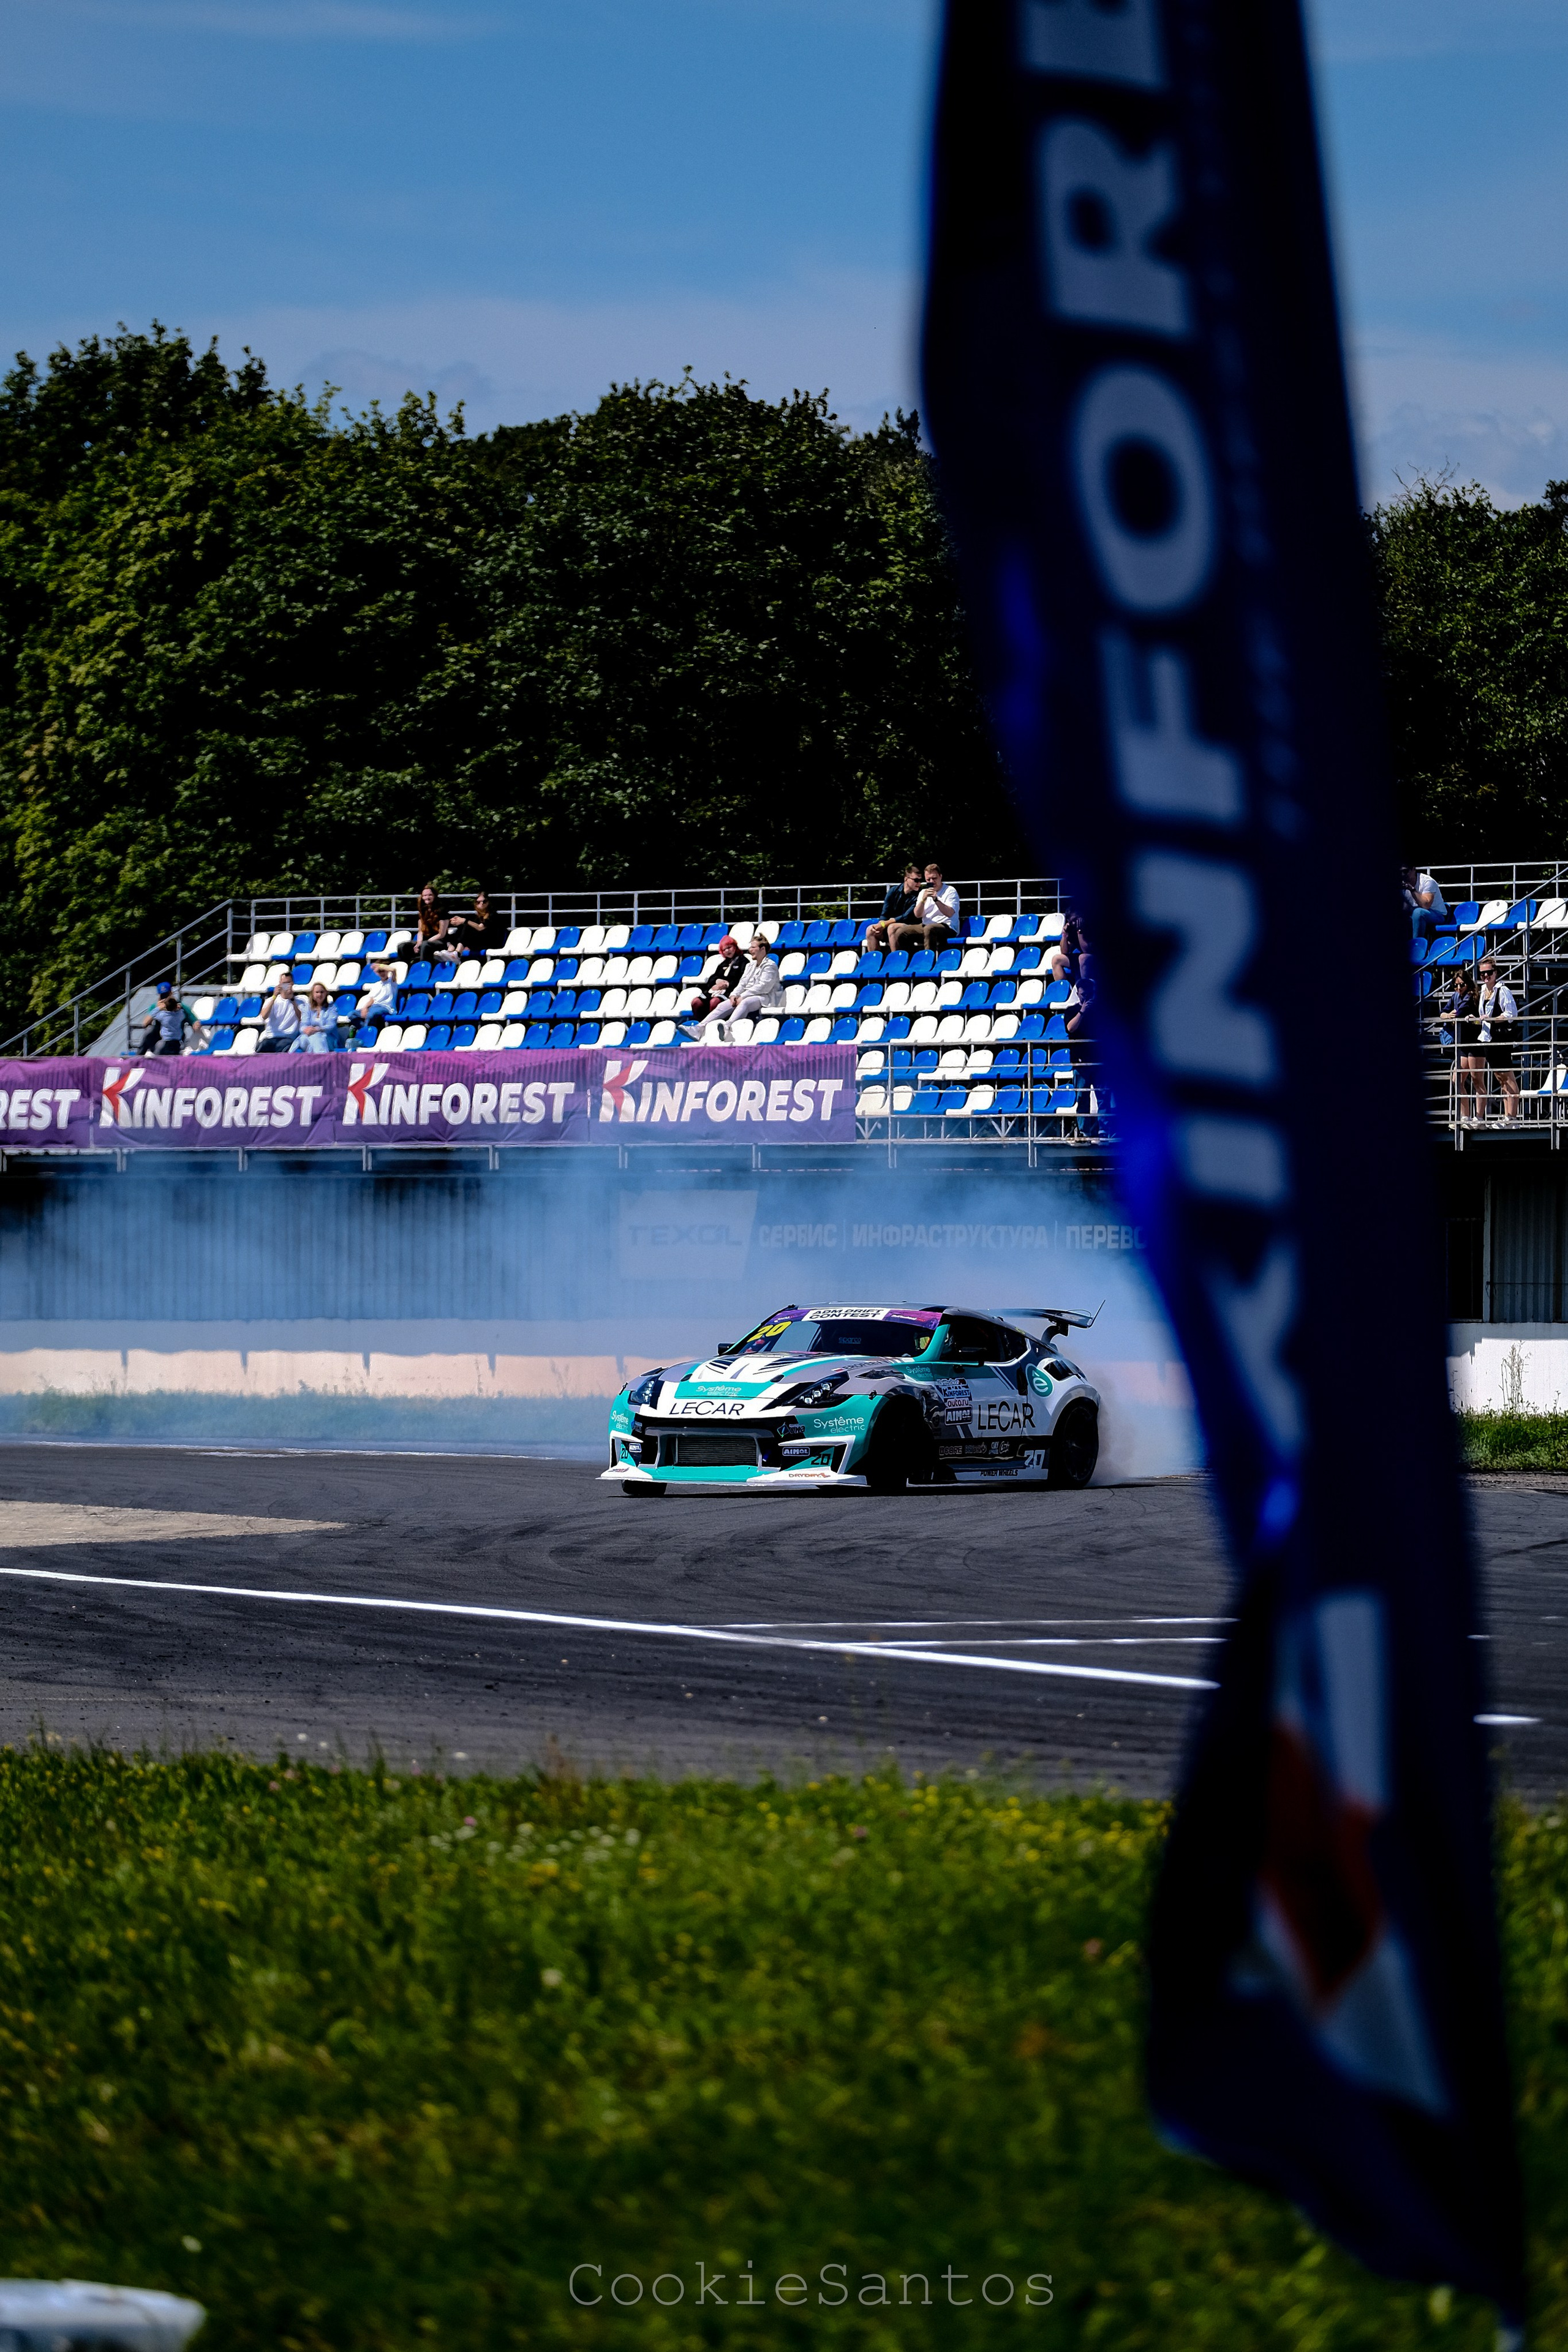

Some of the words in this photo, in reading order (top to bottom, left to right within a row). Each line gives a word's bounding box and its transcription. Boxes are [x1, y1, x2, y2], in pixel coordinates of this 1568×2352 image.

[99, 1068, 323, 1129] KINFOREST
[342, 1063, 575, 1126] KINFOREST
[598, 1060, 843, 1123] KINFOREST
[758, 1223, 838, 1248] СЕРВИС
[852, 1224, 1049, 1249] ИНФРАСТРУКТУРА
[747, 1321, 791, 1343] 20
[669, 1401, 745, 1415] LECAR
[978, 1401, 1036, 1432] LECAR
[830, 1424, 865, 1433] electric
[810, 1453, 831, 1465] 20
[1024, 1450, 1046, 1469] 20
